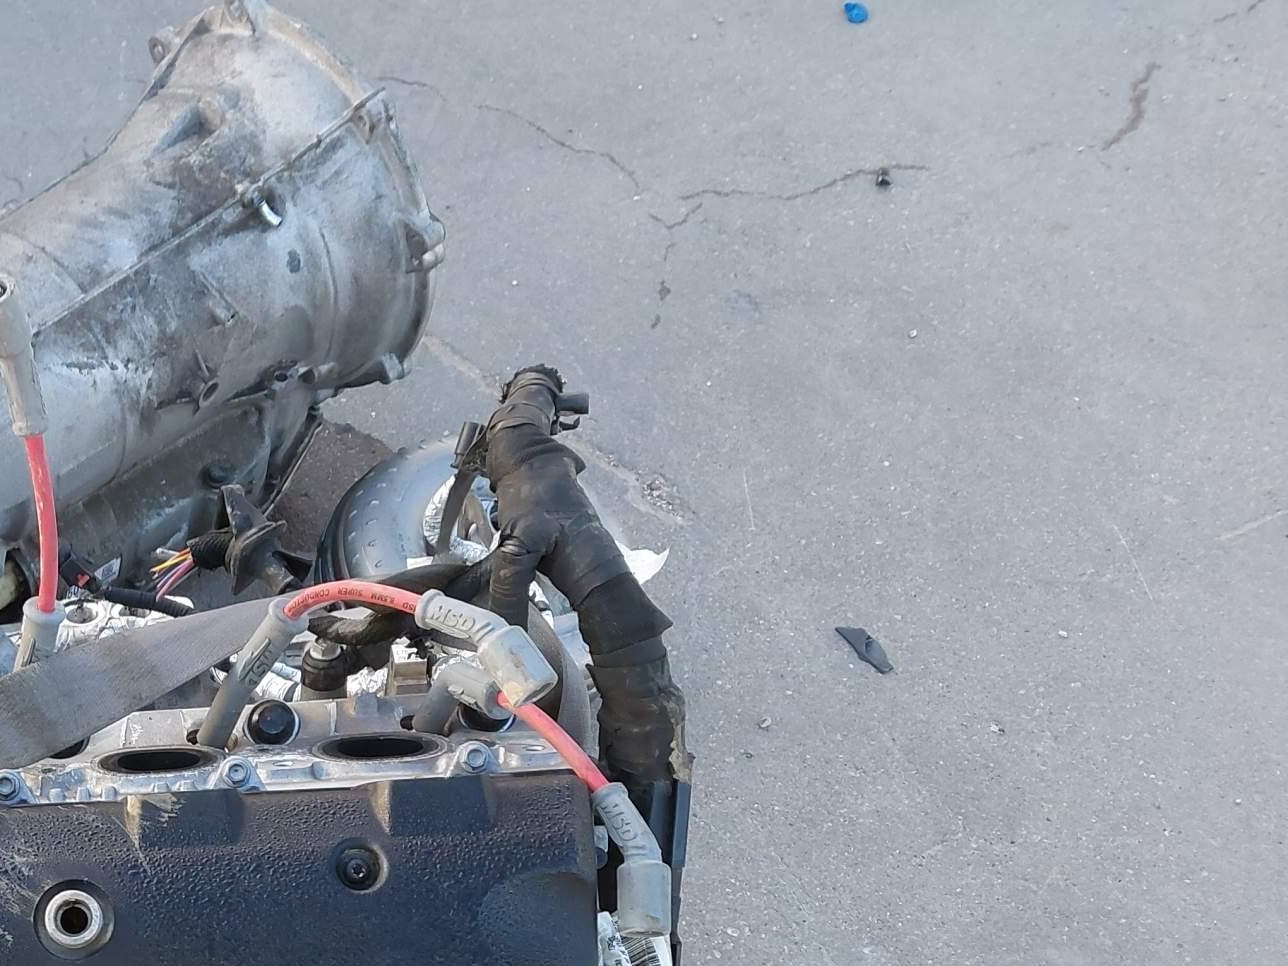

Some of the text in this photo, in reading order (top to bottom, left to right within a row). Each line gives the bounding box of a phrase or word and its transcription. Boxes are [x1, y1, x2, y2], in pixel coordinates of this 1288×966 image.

[337, 587, 363, 597] SUPER
[428, 604, 476, 633] MSD
[598, 802, 638, 847] MSD
